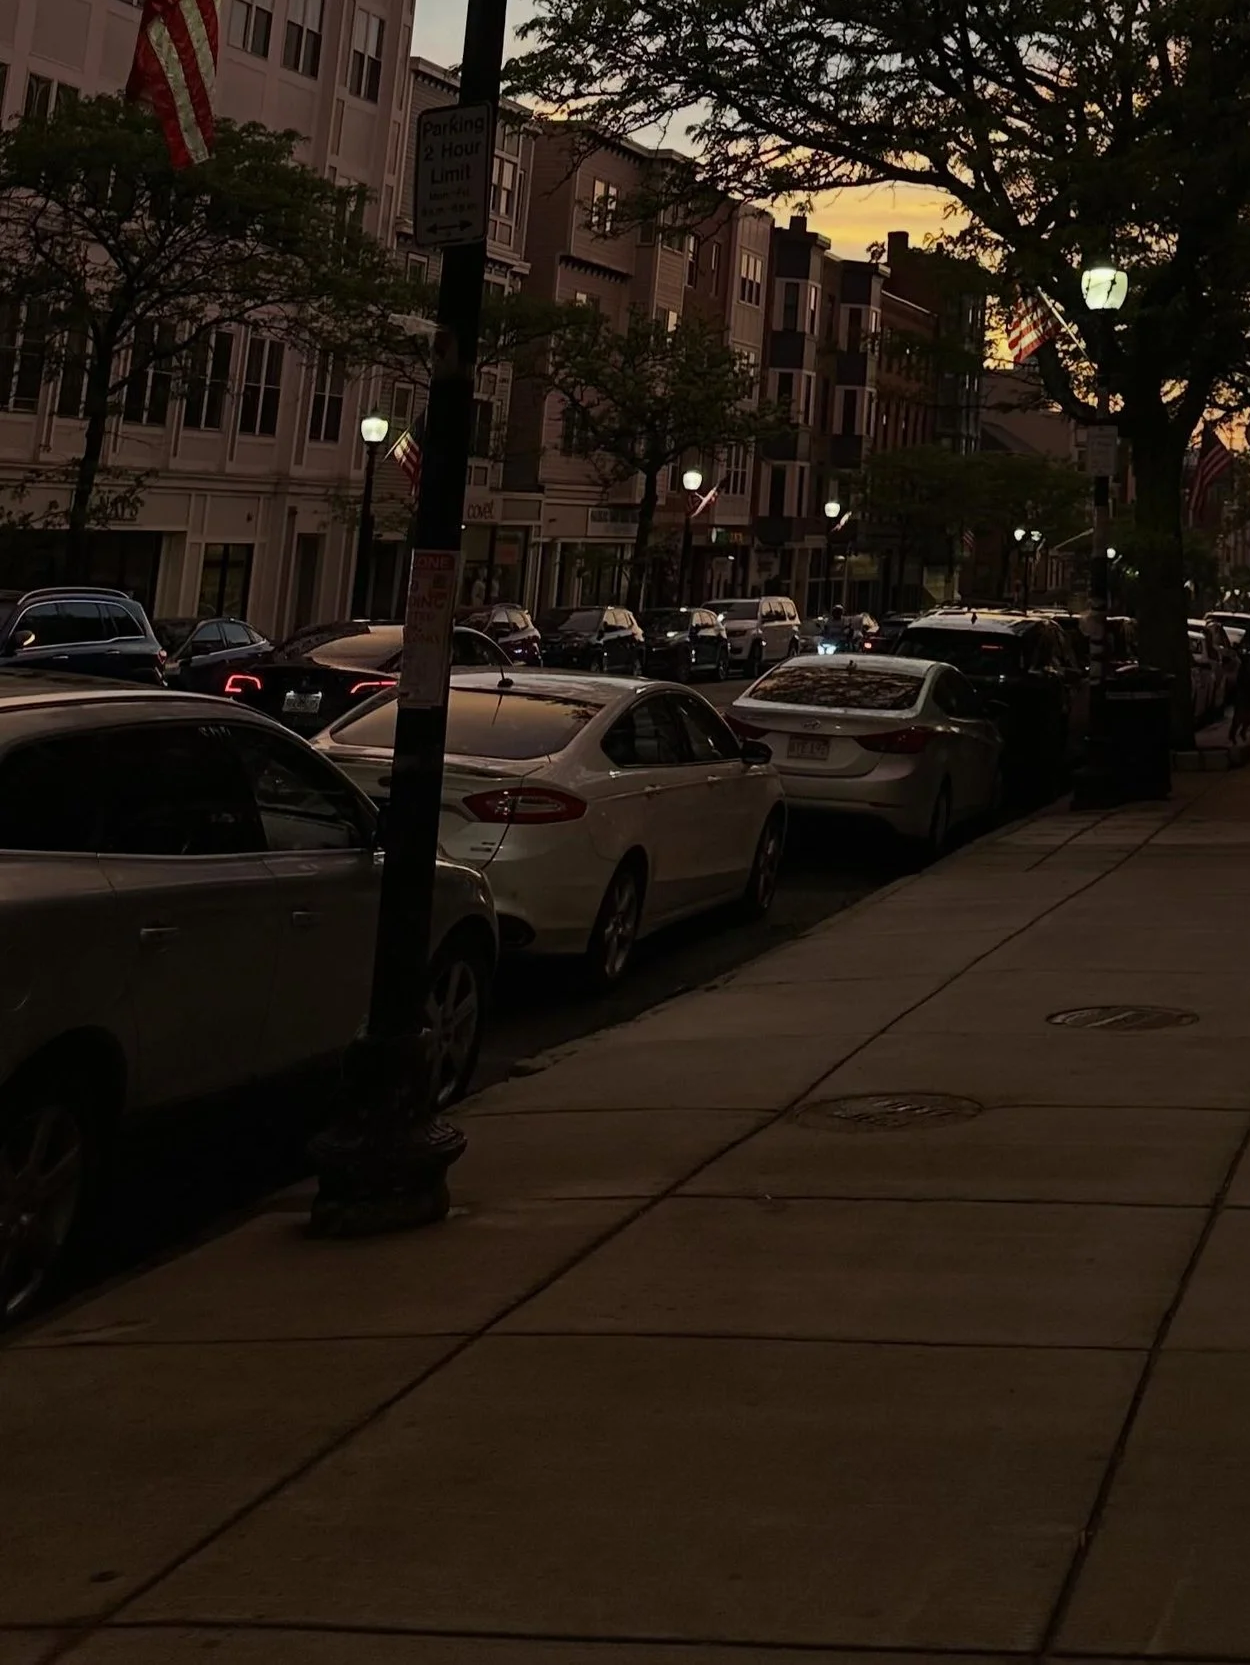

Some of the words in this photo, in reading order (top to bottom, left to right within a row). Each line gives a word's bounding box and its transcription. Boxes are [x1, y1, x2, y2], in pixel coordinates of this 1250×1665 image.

[422, 113, 485, 139] Parking
[423, 144, 435, 162] 2
[441, 140, 482, 159] Hour
[431, 164, 471, 184] Limit
